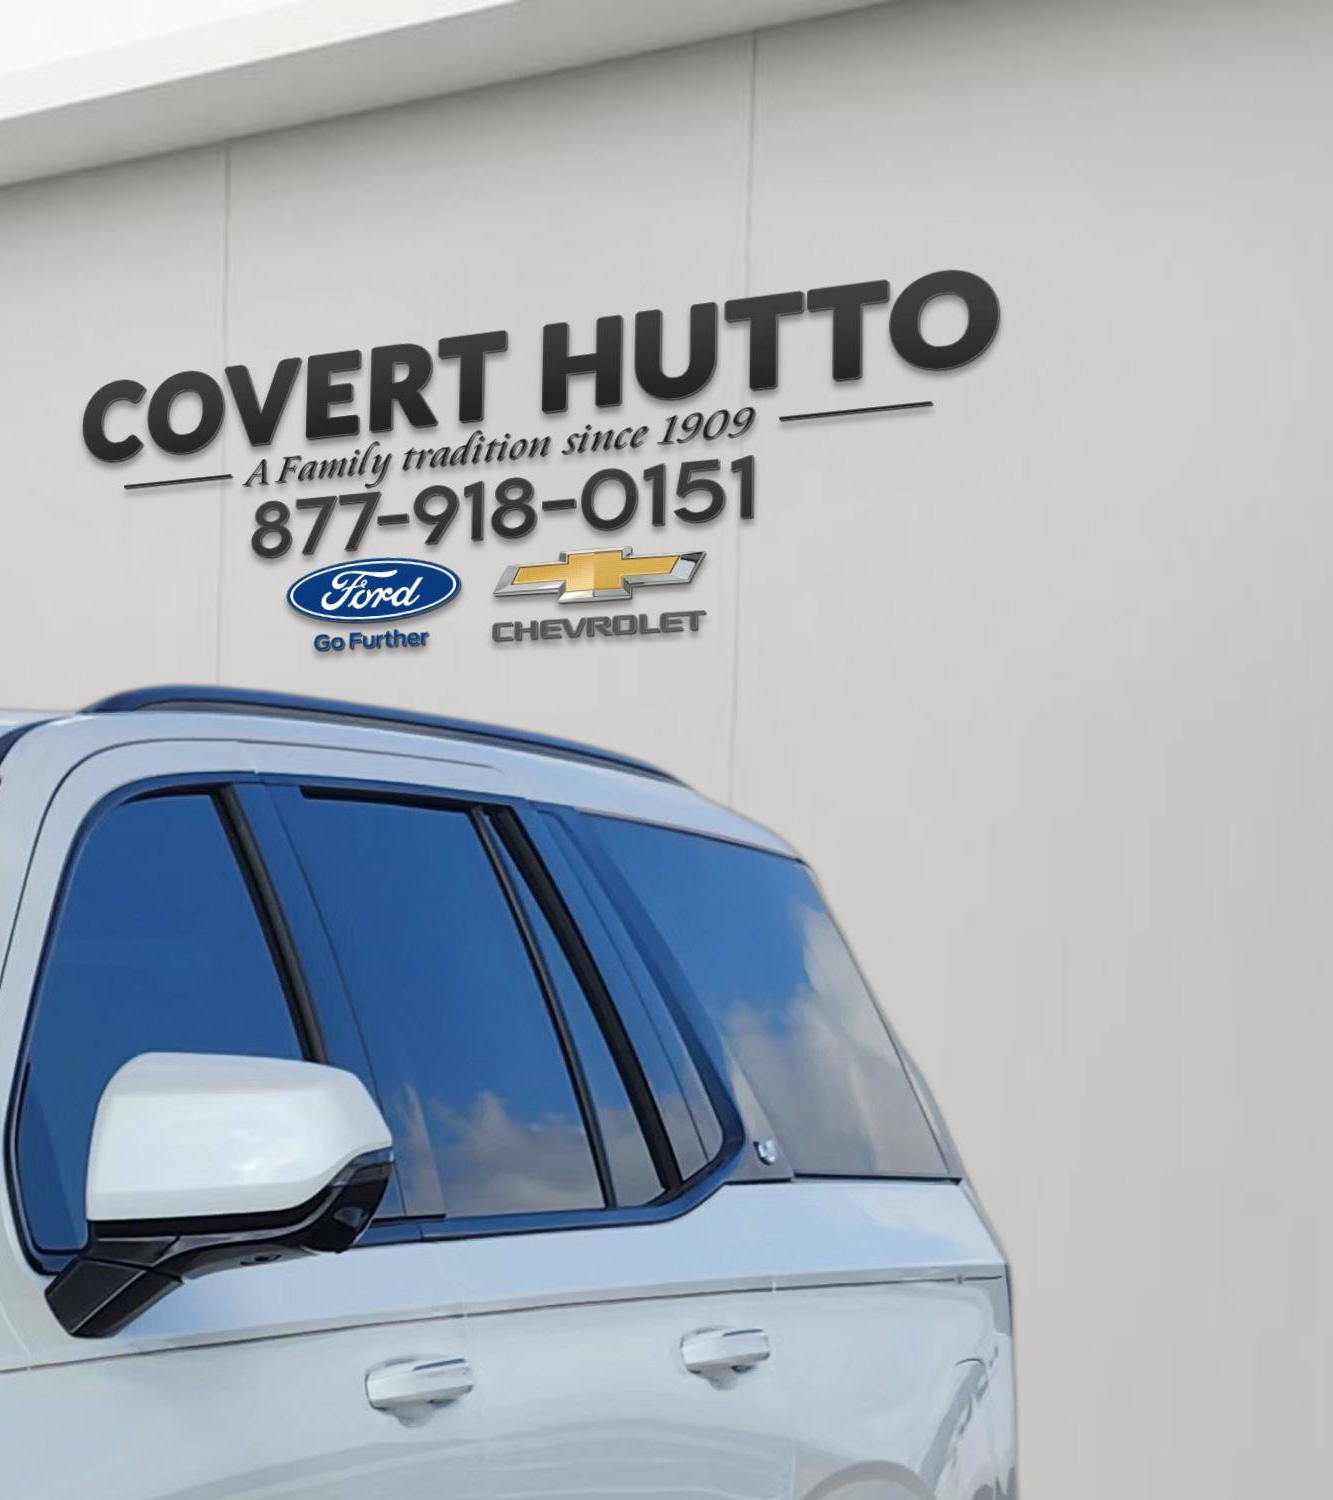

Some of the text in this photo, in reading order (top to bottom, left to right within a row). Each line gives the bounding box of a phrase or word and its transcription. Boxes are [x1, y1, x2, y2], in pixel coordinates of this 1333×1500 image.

[81, 268, 1002, 465] COVERT HUTTO
[241, 405, 757, 490] A Family tradition since 1909
[250, 454, 756, 561] 877-918-0151
[319, 568, 424, 612] Ford
[312, 628, 431, 654] Go Further
[491, 609, 708, 644] CHEVROLET
